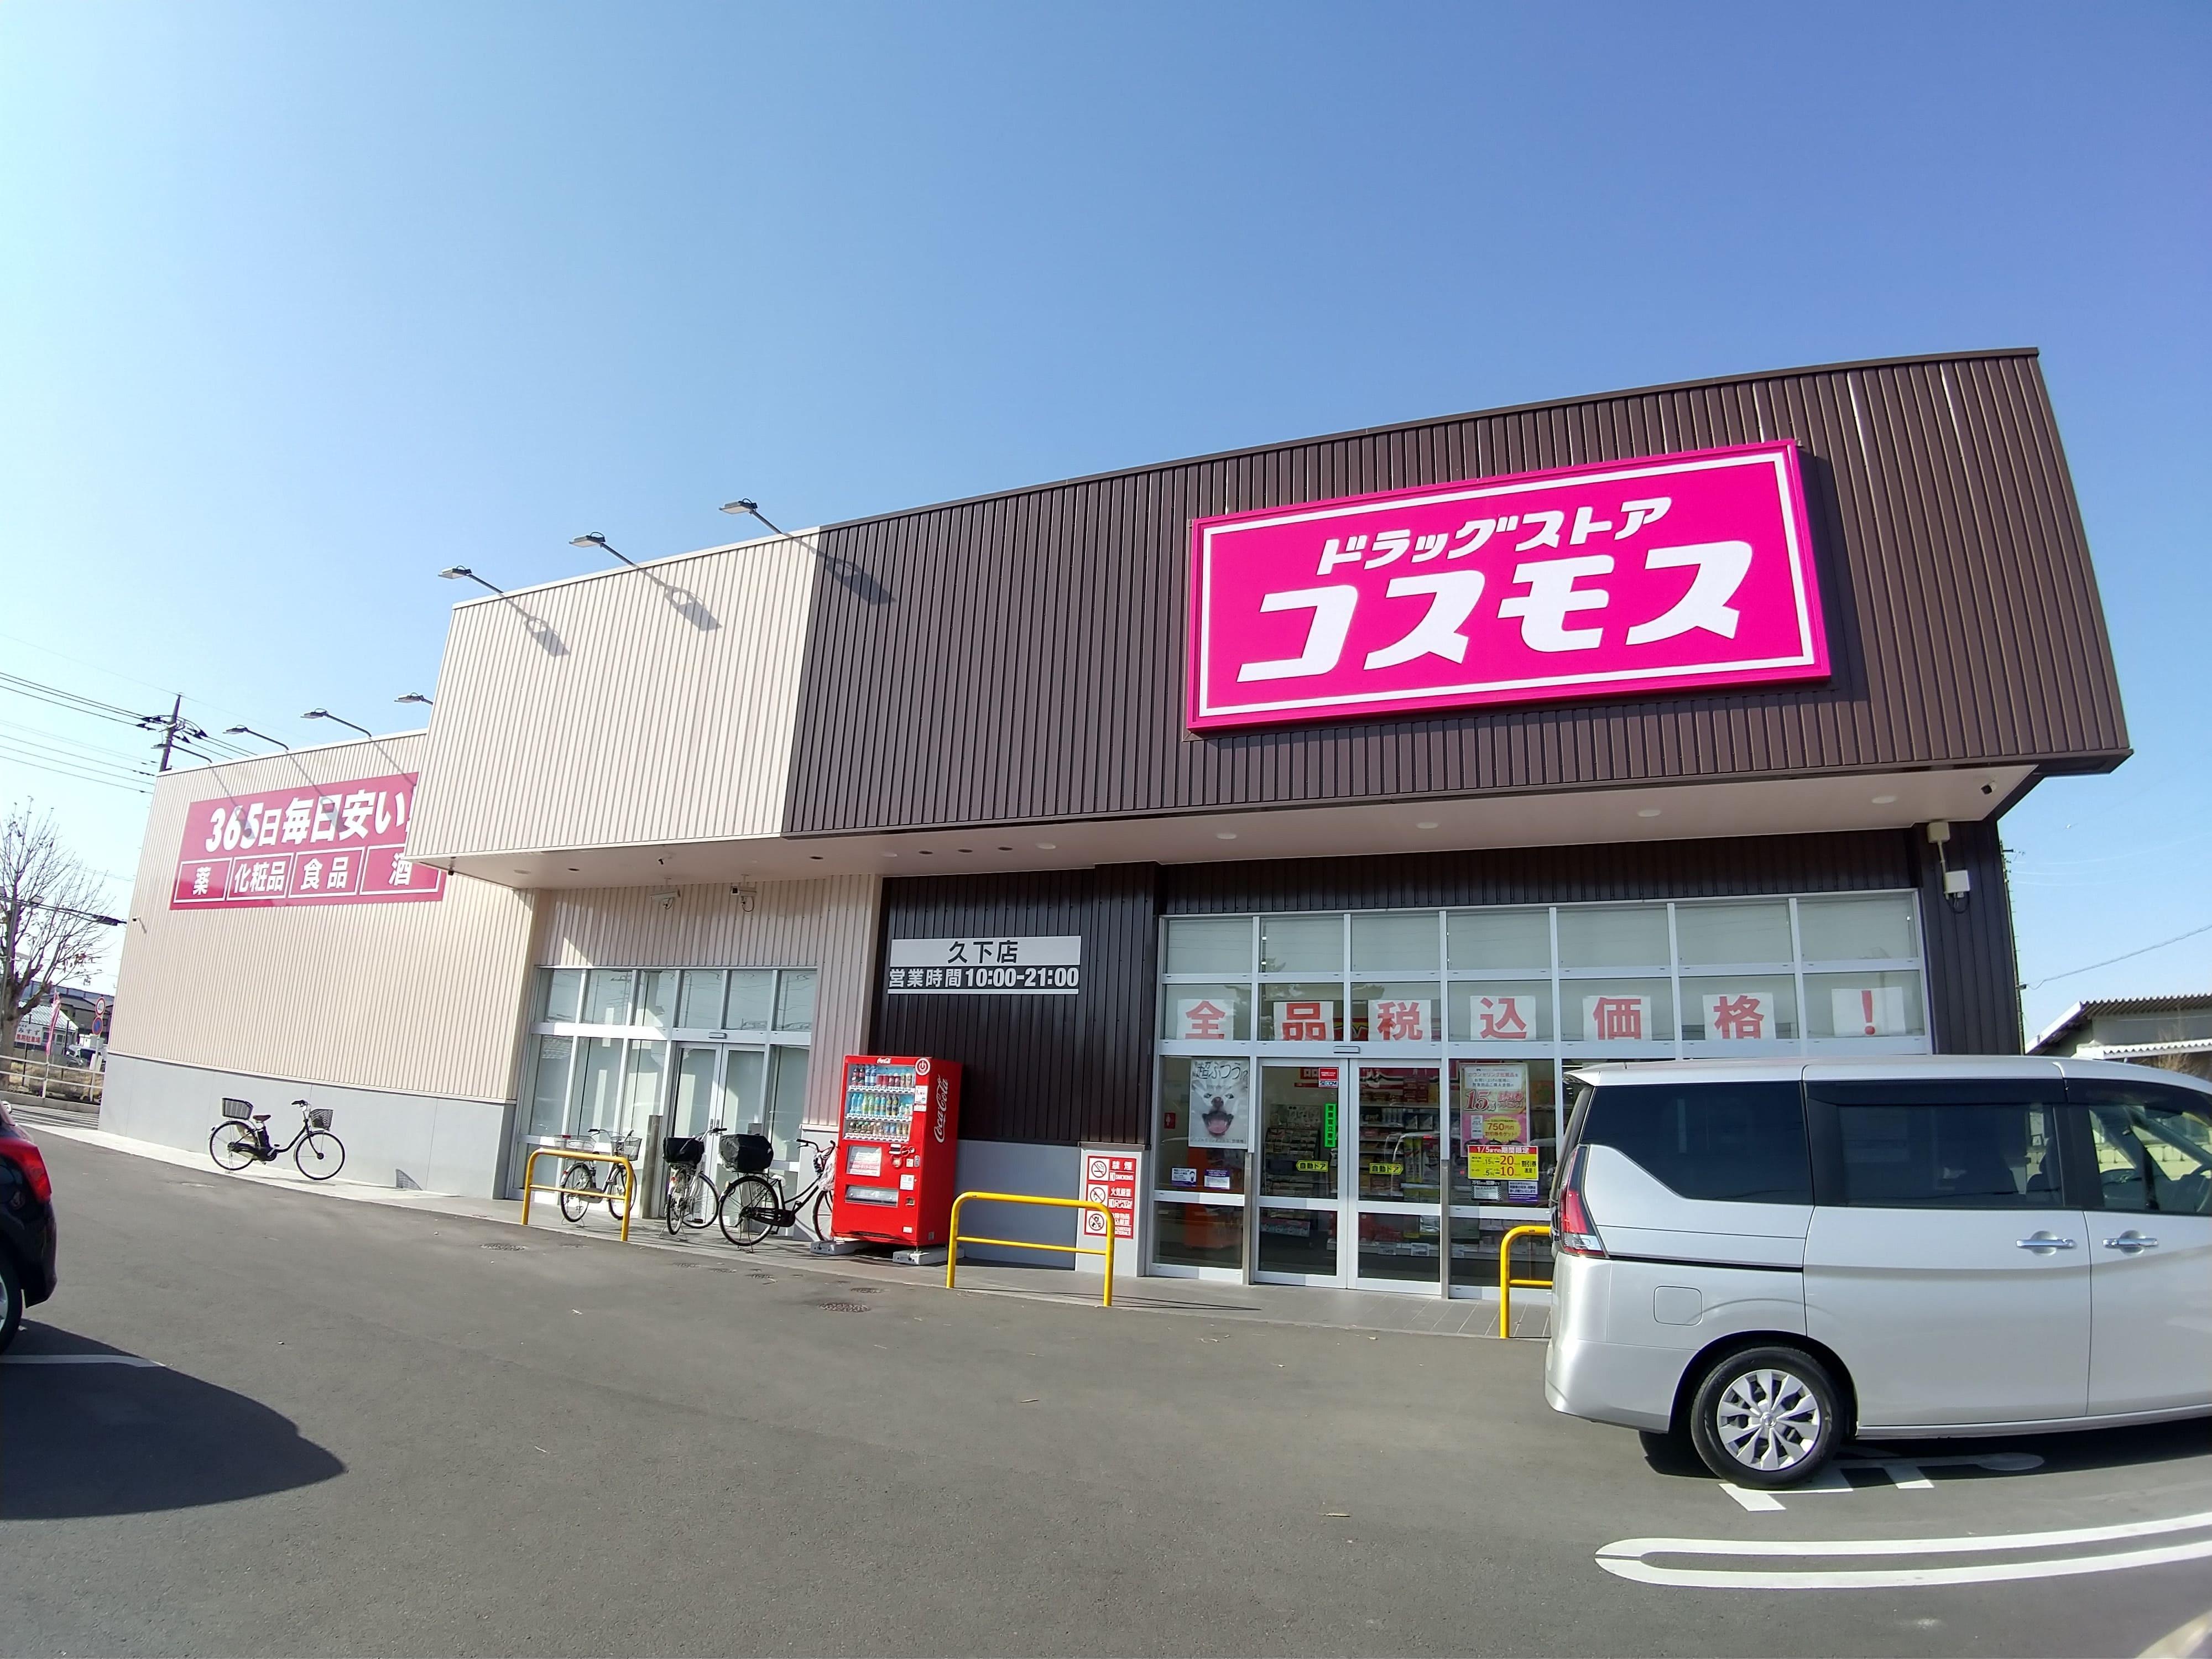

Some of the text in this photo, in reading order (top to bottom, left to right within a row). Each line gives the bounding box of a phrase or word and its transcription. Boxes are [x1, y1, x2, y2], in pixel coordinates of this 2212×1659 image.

[1317, 497, 1672, 576] ドラッグストア
[1237, 540, 1755, 684] コスモス
[205, 789, 410, 853] 365日毎日安い
[192, 867, 211, 896] 薬
[233, 861, 285, 894] 化粧品
[947, 940, 1019, 964] 久下店
[933, 1073, 948, 1143] Coca-Cola
